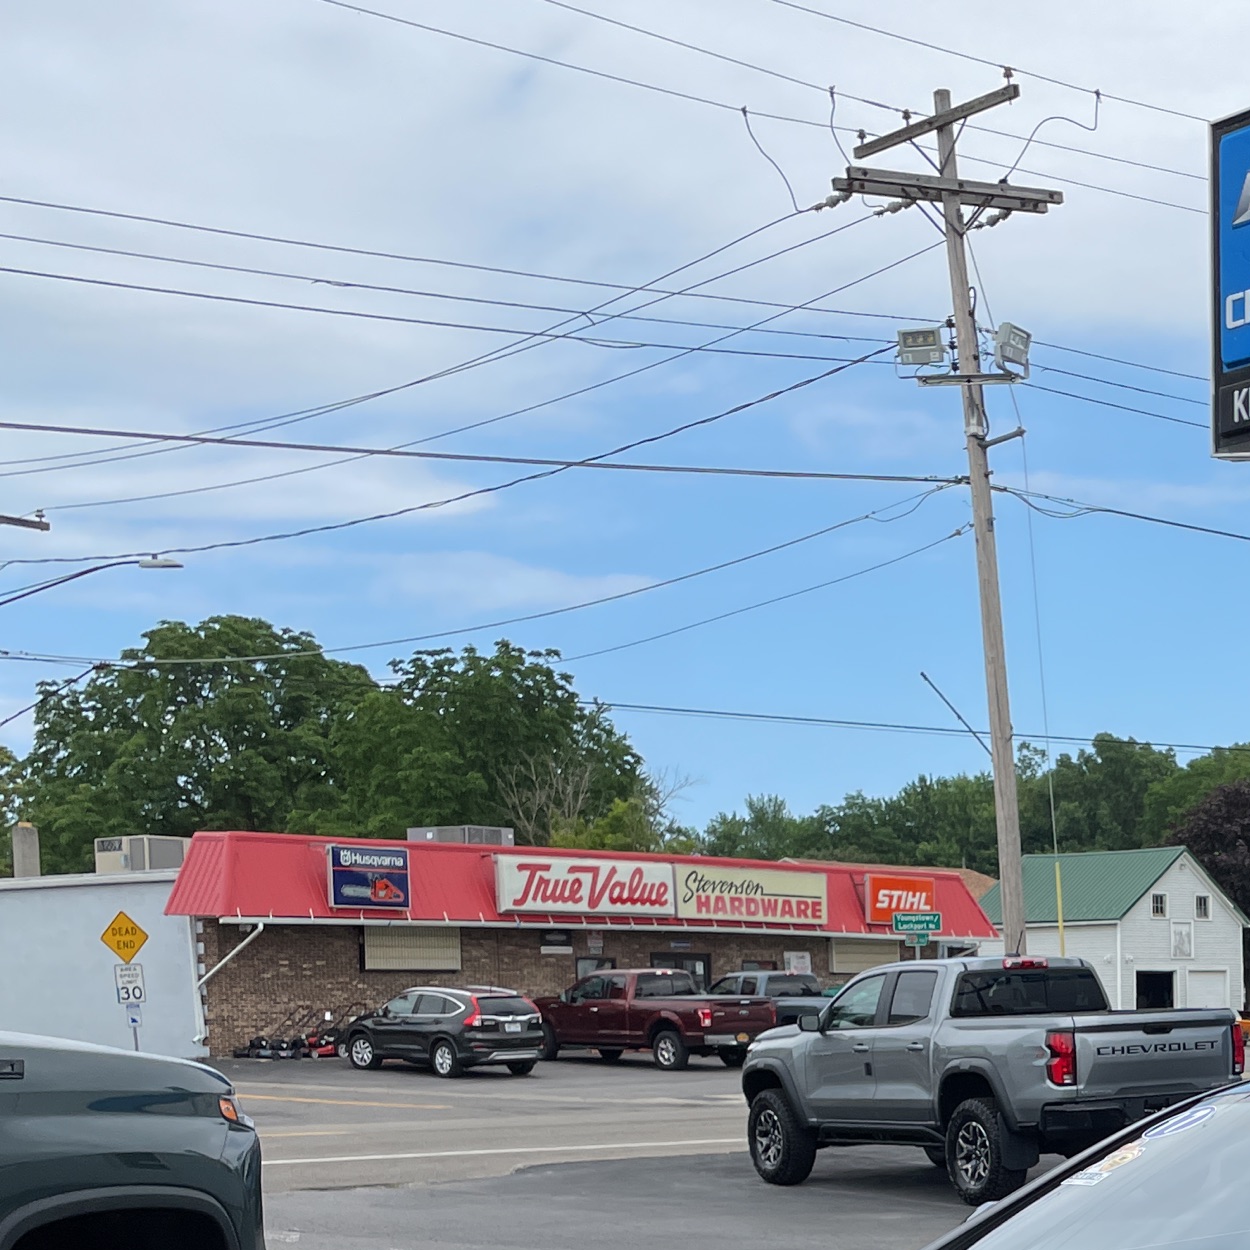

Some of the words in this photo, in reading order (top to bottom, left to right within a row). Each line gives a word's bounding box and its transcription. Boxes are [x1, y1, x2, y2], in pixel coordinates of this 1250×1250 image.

[352, 853, 404, 867] Husqvarna
[512, 863, 583, 907] True
[567, 865, 668, 909] Value
[683, 870, 764, 903] Stevenson
[696, 895, 822, 919] HARDWARE
[876, 889, 931, 911] STIHL
[112, 927, 137, 937] DEAD
[117, 940, 135, 949] END
[121, 986, 142, 1000] 30
[1096, 1040, 1218, 1056] CHEVROLET
